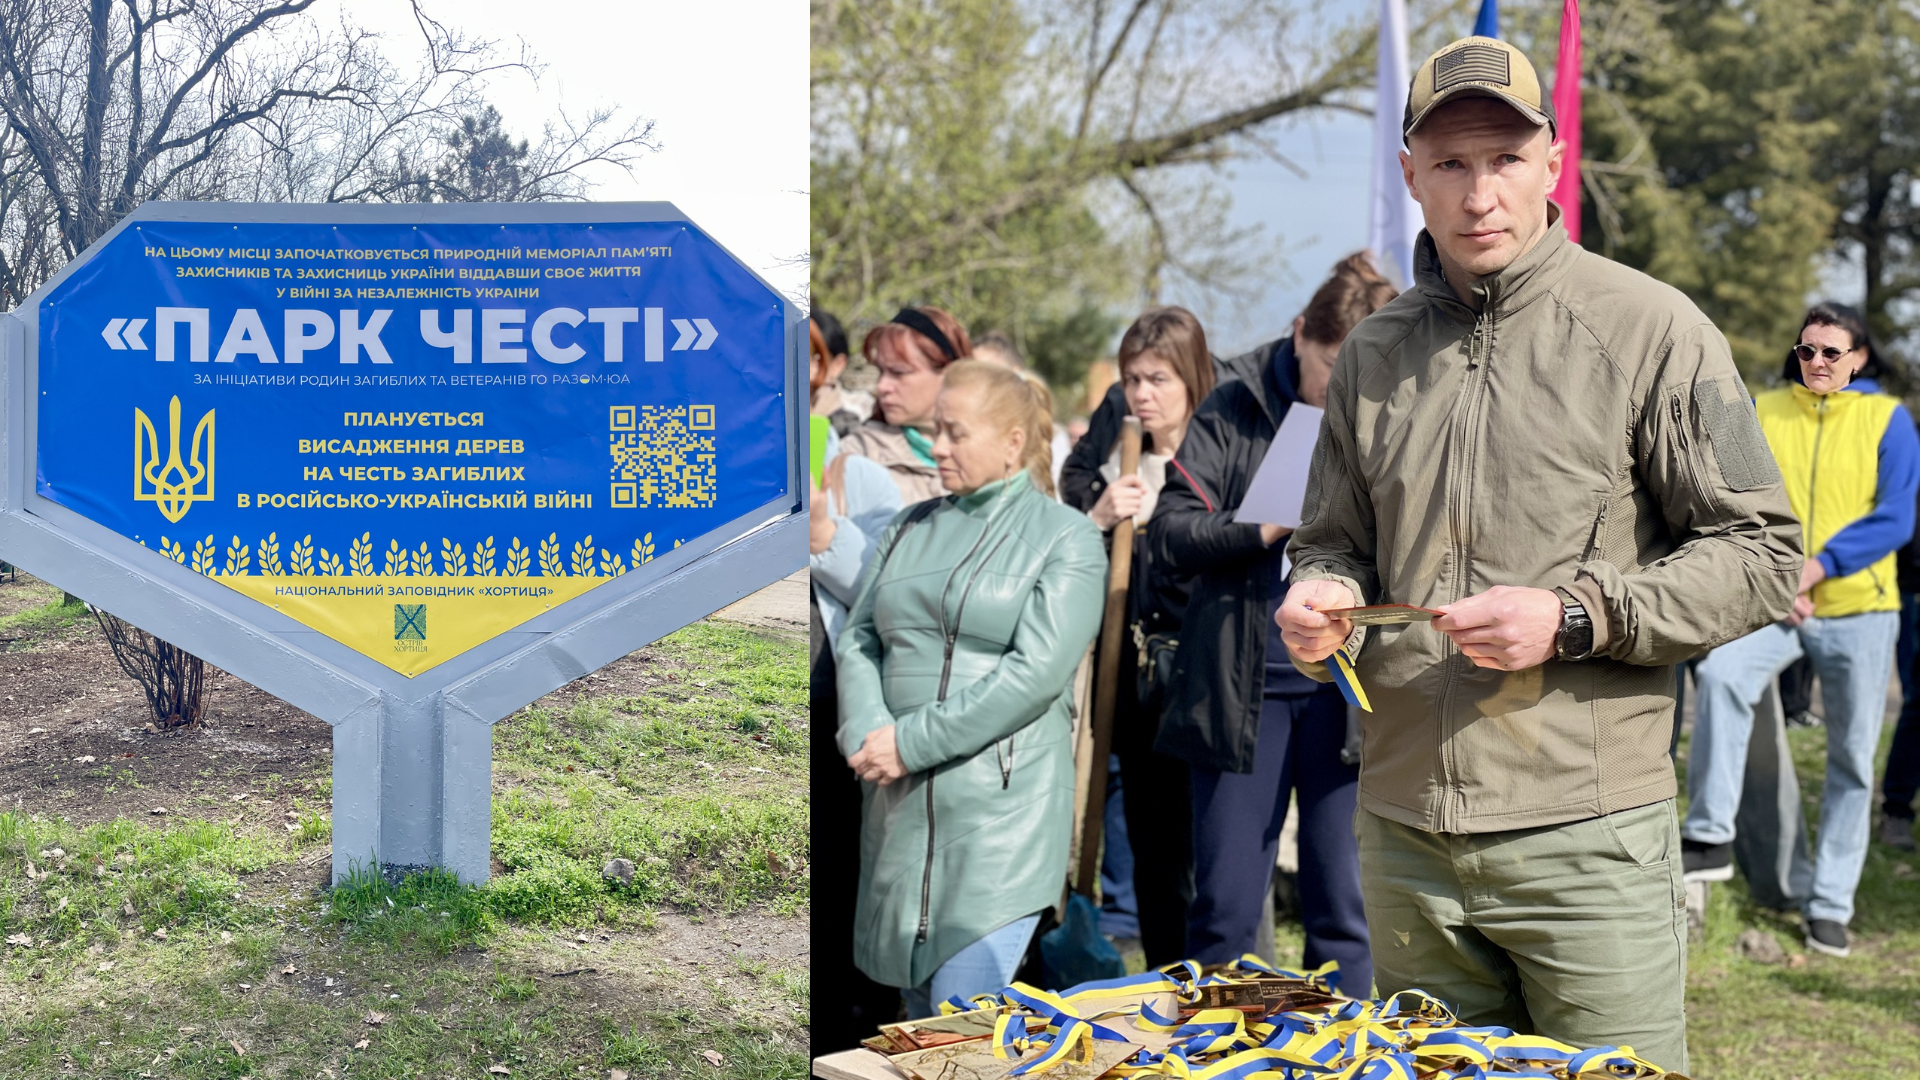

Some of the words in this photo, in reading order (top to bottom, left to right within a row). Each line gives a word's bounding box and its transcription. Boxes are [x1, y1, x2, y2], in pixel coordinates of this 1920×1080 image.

[144, 246, 167, 258] НА
[170, 246, 225, 260] ЦЬОМУ
[228, 247, 271, 261] МІСЦІ
[274, 248, 429, 260] ЗАПОЧАТКОВУЄТЬСЯ
[433, 246, 522, 262] ПРИРОДНІЙ
[526, 247, 607, 260] МЕМОРІАЛ
[176, 266, 271, 279] ЗАХИСНИКІВ
[273, 267, 293, 279] ТА
[296, 268, 387, 281] ЗАХИСНИЦЬ
[390, 265, 455, 280] УКРАЇНИ
[458, 267, 541, 281] ВІДДАВШИ
[544, 267, 585, 279] СВОЄ
[588, 265, 641, 278] ЖИТТЯ
[276, 287, 286, 299] У
[290, 285, 330, 299] ВІЙНІ
[333, 287, 353, 299] ЗА
[357, 287, 472, 299] НЕЗАЛЕЖНІСТЬ
[101, 306, 394, 364] «ПАРК
[419, 306, 719, 365] ЧЕСТІ»
[194, 373, 212, 385] ЗА
[216, 374, 295, 387] ІНІЦІАТИВИ
[300, 375, 350, 388] РОДИН
[353, 375, 427, 386] ЗАГИБЛИХ
[430, 375, 447, 386] ТА
[450, 374, 527, 386] ВЕТЕРАНІВ
[530, 374, 548, 385] ГО
[343, 411, 484, 427] ПЛАНУЄТЬСЯ
[298, 439, 450, 457] ВИСАДЖЕННЯ
[454, 439, 525, 457] ДЕРЕВ
[303, 466, 334, 481] НА
[339, 466, 407, 482] ЧЕСТЬ
[411, 466, 526, 482] ЗАГИБЛИХ
[237, 493, 251, 508] В
[257, 490, 527, 509] РОСІЙСЬКО-УКРАЇНСЬКІЙ
[534, 490, 592, 509] ВІЙНІ
[275, 584, 384, 598] НАЦІОНАЛЬНИЙ
[387, 586, 475, 598] ЗАПОВІДНИК
[478, 586, 554, 599] «ХОРТИЦЯ»
[393, 645, 428, 653] ХОРТИЦЯ
